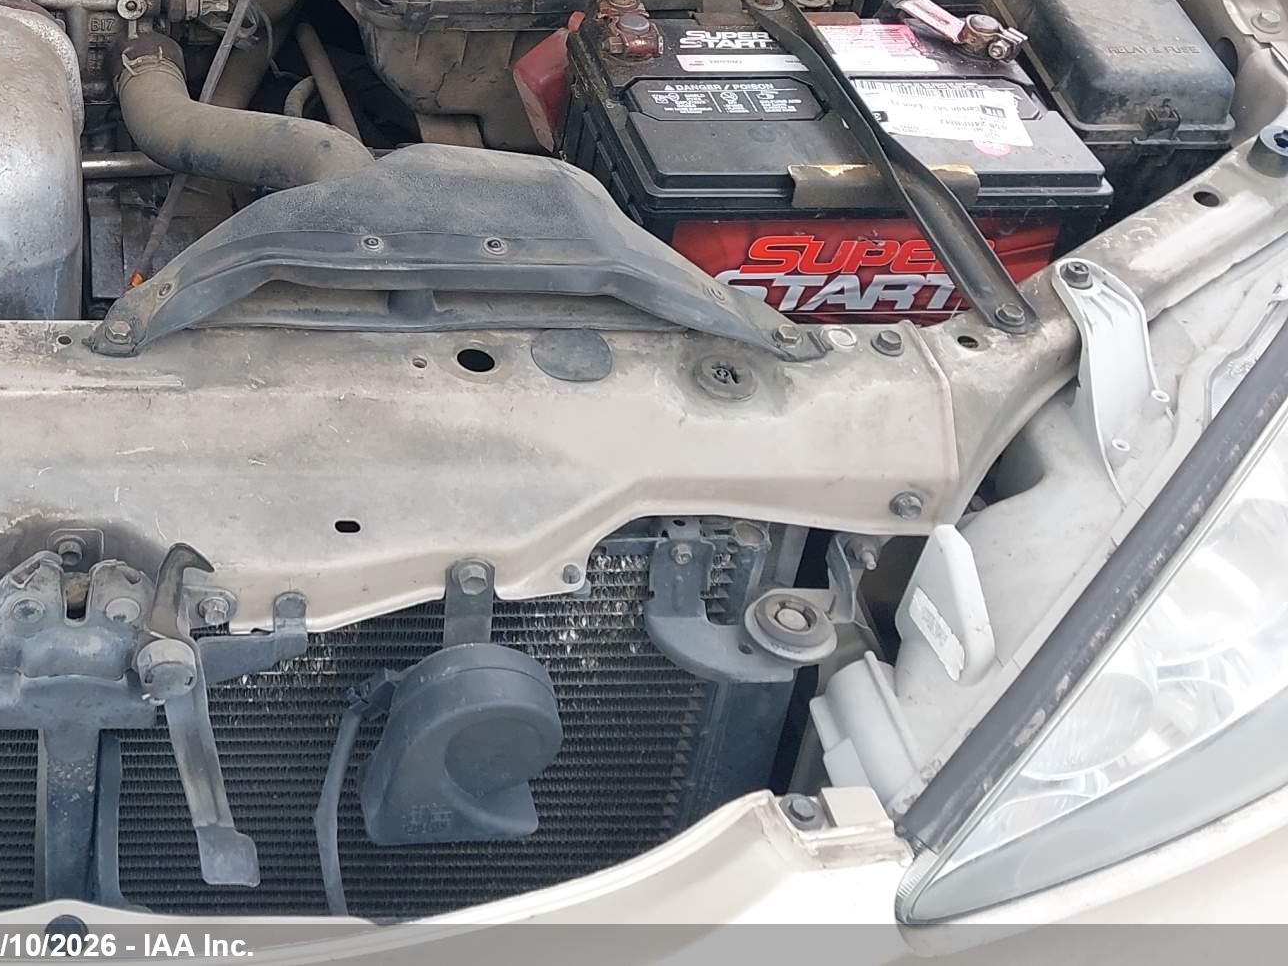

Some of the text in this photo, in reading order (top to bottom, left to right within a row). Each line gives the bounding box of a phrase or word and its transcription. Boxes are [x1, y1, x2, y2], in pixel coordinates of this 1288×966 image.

[686, 30, 771, 40] SUPER
[679, 37, 776, 49] START
[739, 235, 995, 274] SUPE
